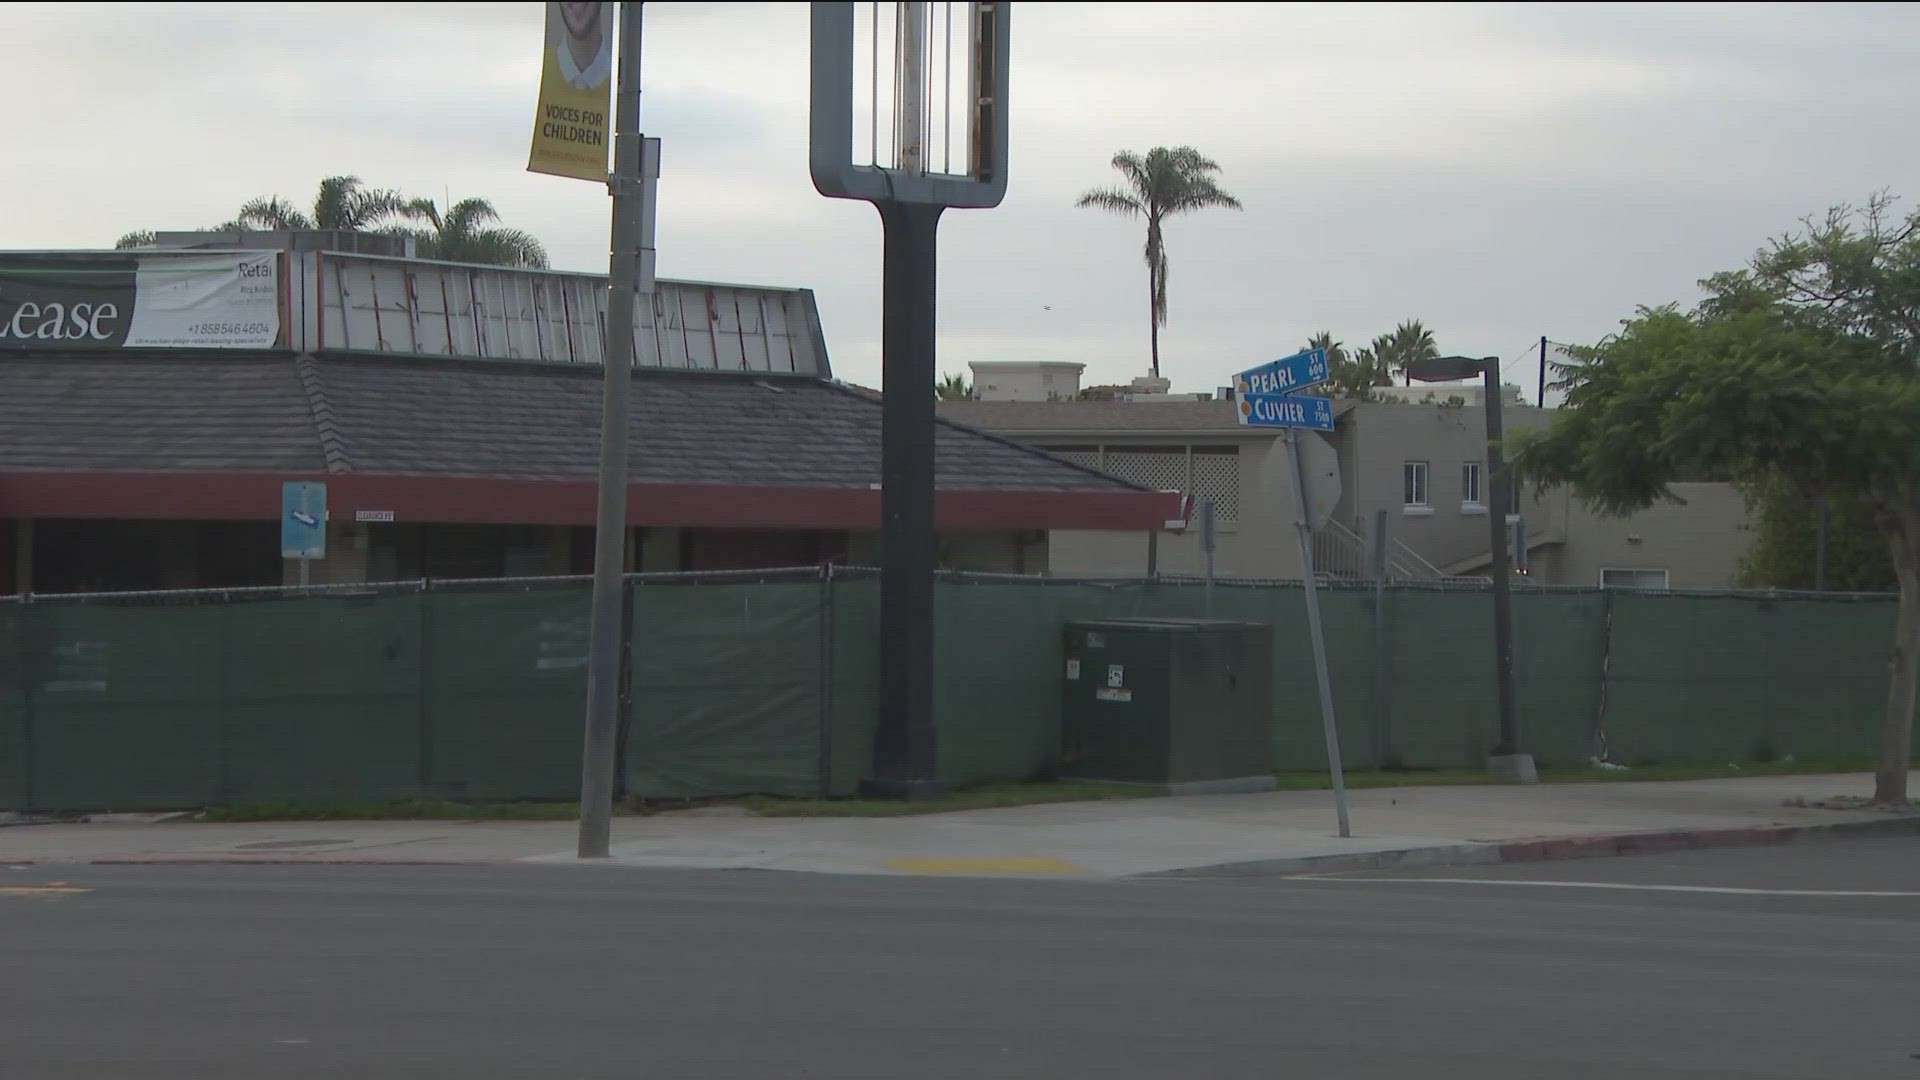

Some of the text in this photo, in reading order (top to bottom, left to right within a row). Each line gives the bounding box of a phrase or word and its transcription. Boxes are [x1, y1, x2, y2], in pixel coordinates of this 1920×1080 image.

[546, 104, 603, 126] VOICES FOR
[543, 122, 601, 146] CHILDREN
[0, 302, 118, 340] ease
[1251, 352, 1319, 394] PEARL ST
[1308, 363, 1324, 377] 600
[1255, 398, 1325, 423] CUVIER ST
